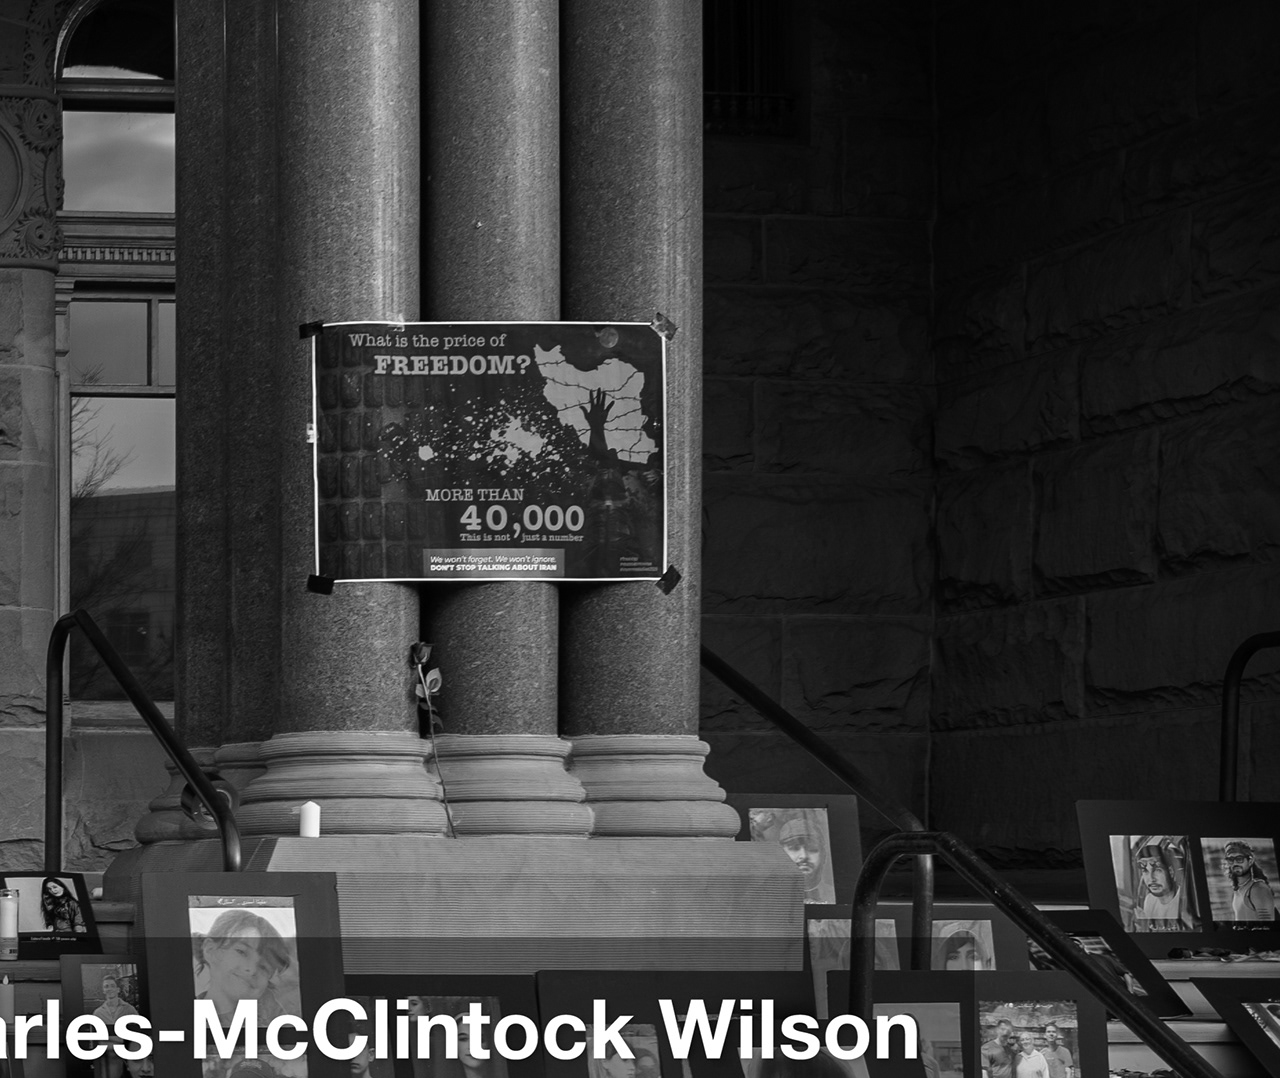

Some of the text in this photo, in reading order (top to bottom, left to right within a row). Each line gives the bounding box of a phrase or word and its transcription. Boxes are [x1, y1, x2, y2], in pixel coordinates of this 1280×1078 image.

[348, 334, 507, 350] What is the price of
[374, 355, 531, 375] FREEDOM?
[425, 488, 524, 501] MORE THAN
[460, 505, 585, 538] 40,000
[460, 533, 481, 541] This
[483, 533, 492, 541] is
[520, 533, 540, 543] just
[549, 534, 584, 542] number
[468, 556, 493, 565] forget.
[532, 556, 557, 564] ignore.
